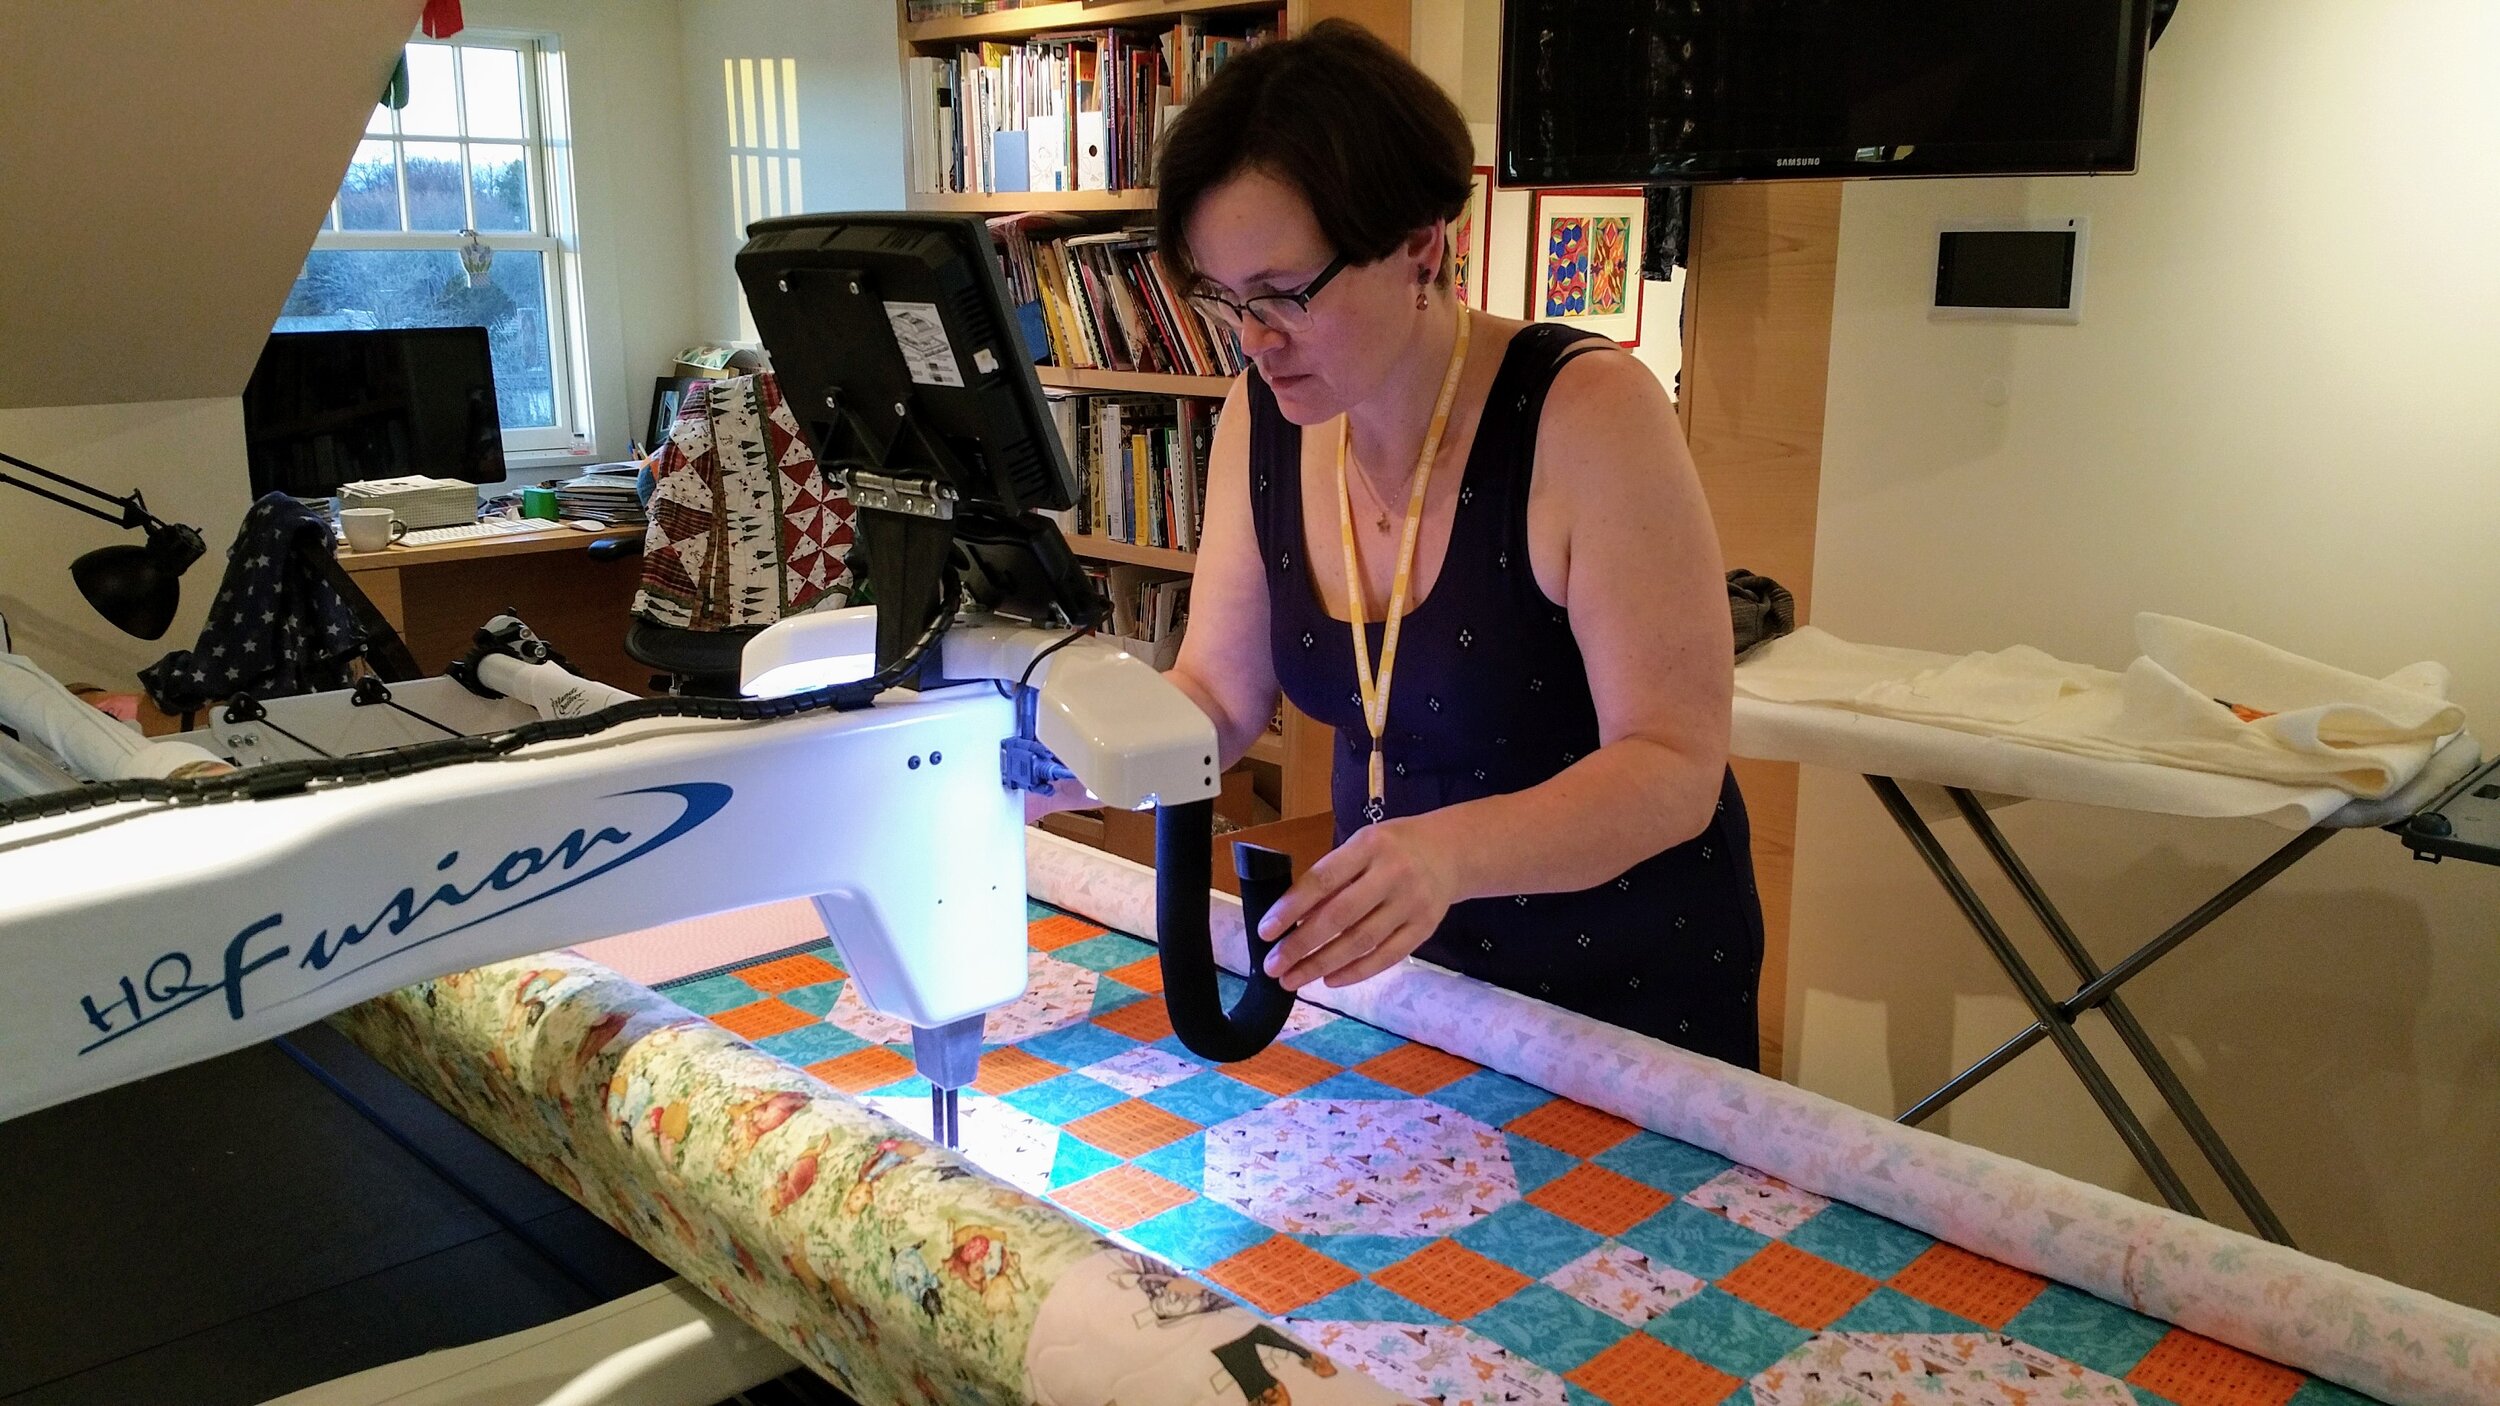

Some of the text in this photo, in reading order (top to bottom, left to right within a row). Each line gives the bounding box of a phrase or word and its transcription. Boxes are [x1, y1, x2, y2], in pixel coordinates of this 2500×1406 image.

[1776, 157, 1820, 167] SAMSUNG
[80, 826, 632, 1033] HQ Fusion
